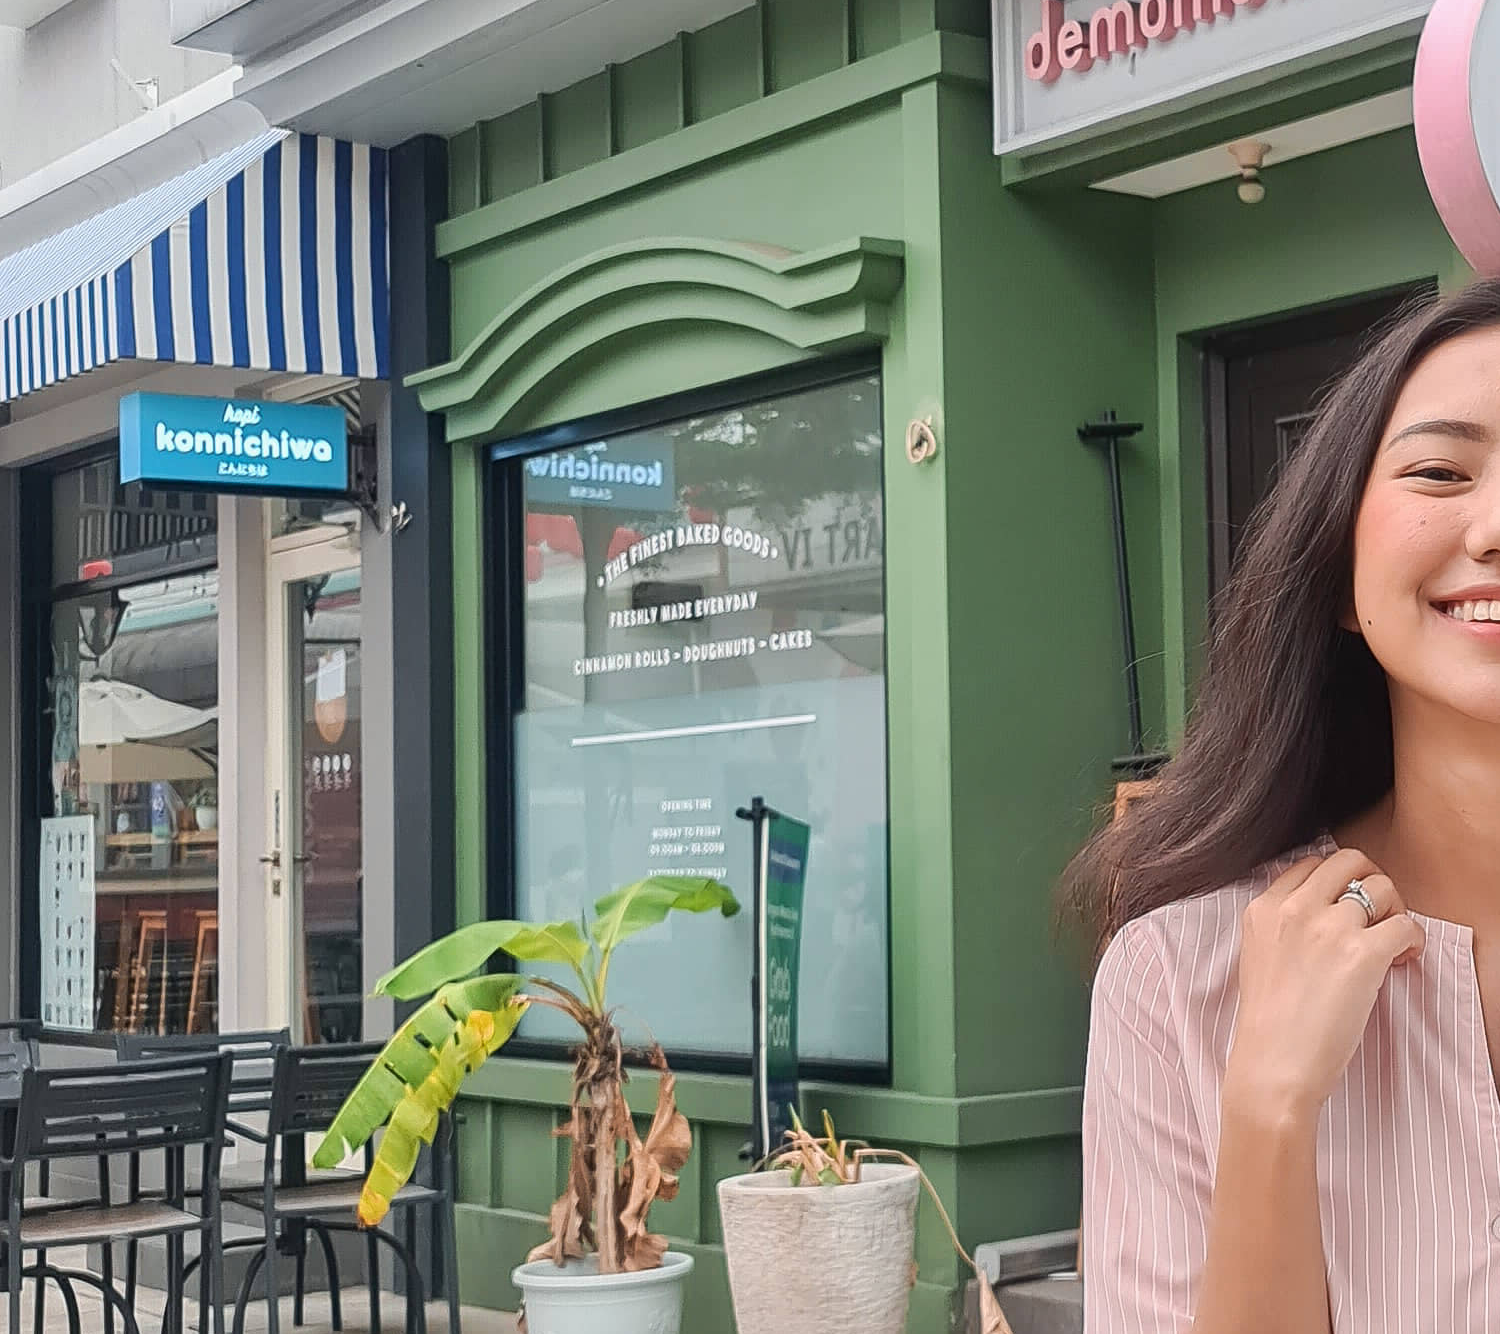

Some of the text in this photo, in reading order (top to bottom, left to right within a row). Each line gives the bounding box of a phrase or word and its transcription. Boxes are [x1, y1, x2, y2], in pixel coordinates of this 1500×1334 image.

[156, 422, 332, 462] konnichiwa
[604, 524, 770, 582] THE FINEST BAKED GOODS
[609, 591, 758, 628] FRESHLY MADE EVERYDAY
[573, 630, 813, 676] CINNAMON ROLLS DOUGHNUTS CAKES
